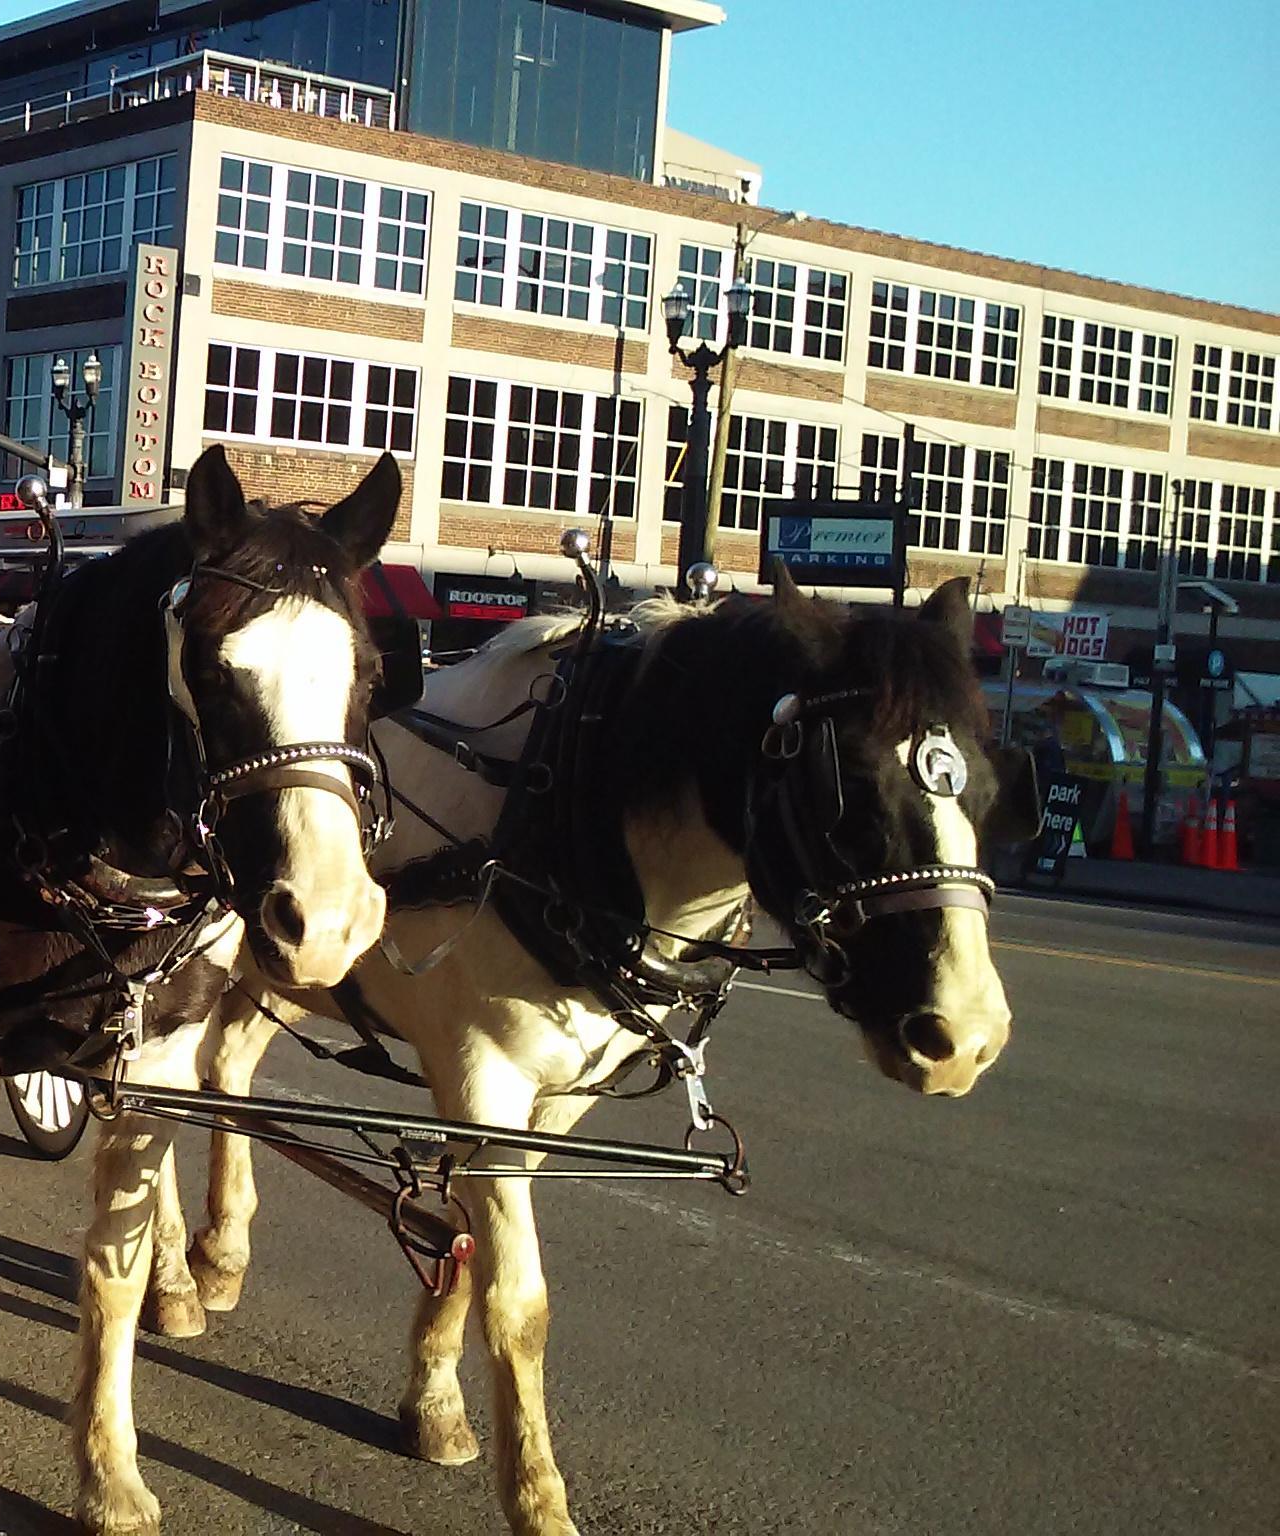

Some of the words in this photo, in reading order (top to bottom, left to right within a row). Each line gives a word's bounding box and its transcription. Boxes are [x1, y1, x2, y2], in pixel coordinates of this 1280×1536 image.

[139, 255, 169, 349] ROCK
[129, 361, 163, 499] BOTTOM
[780, 521, 887, 546] Premier
[771, 553, 886, 565] ARKING
[449, 590, 528, 606] ROOFTOP
[1063, 616, 1101, 635] HOT
[1047, 783, 1082, 805] park
[1042, 806, 1073, 832] here
